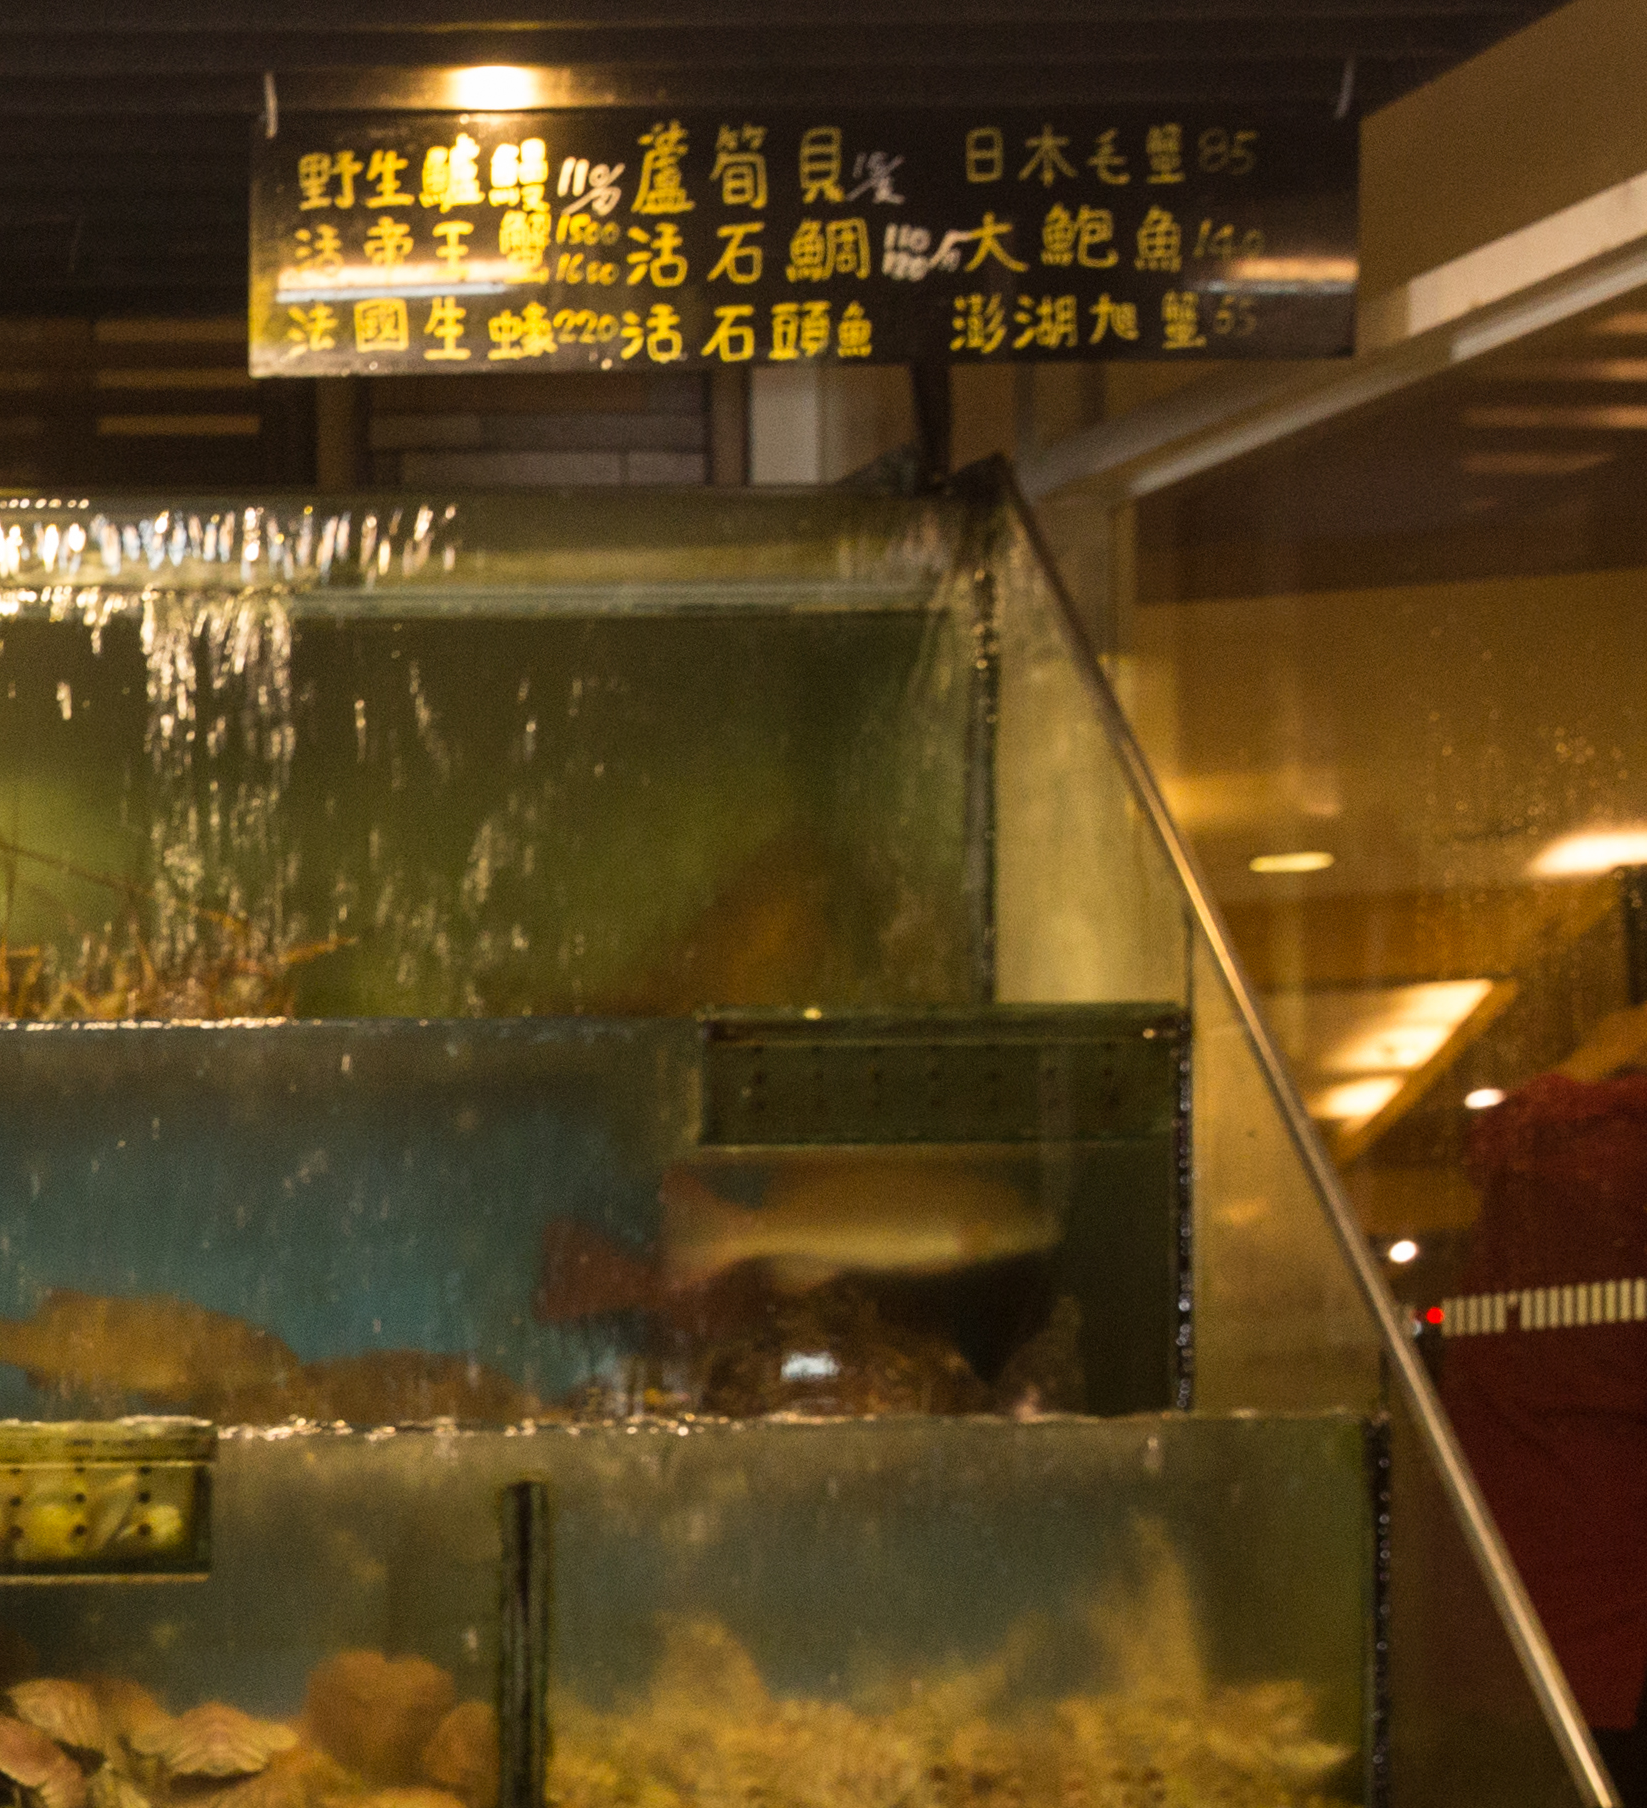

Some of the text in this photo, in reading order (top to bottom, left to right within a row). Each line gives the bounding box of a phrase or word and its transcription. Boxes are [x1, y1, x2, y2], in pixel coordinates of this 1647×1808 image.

[964, 201, 1183, 273] 大鮑魚
[620, 300, 872, 363] 活石頭魚
